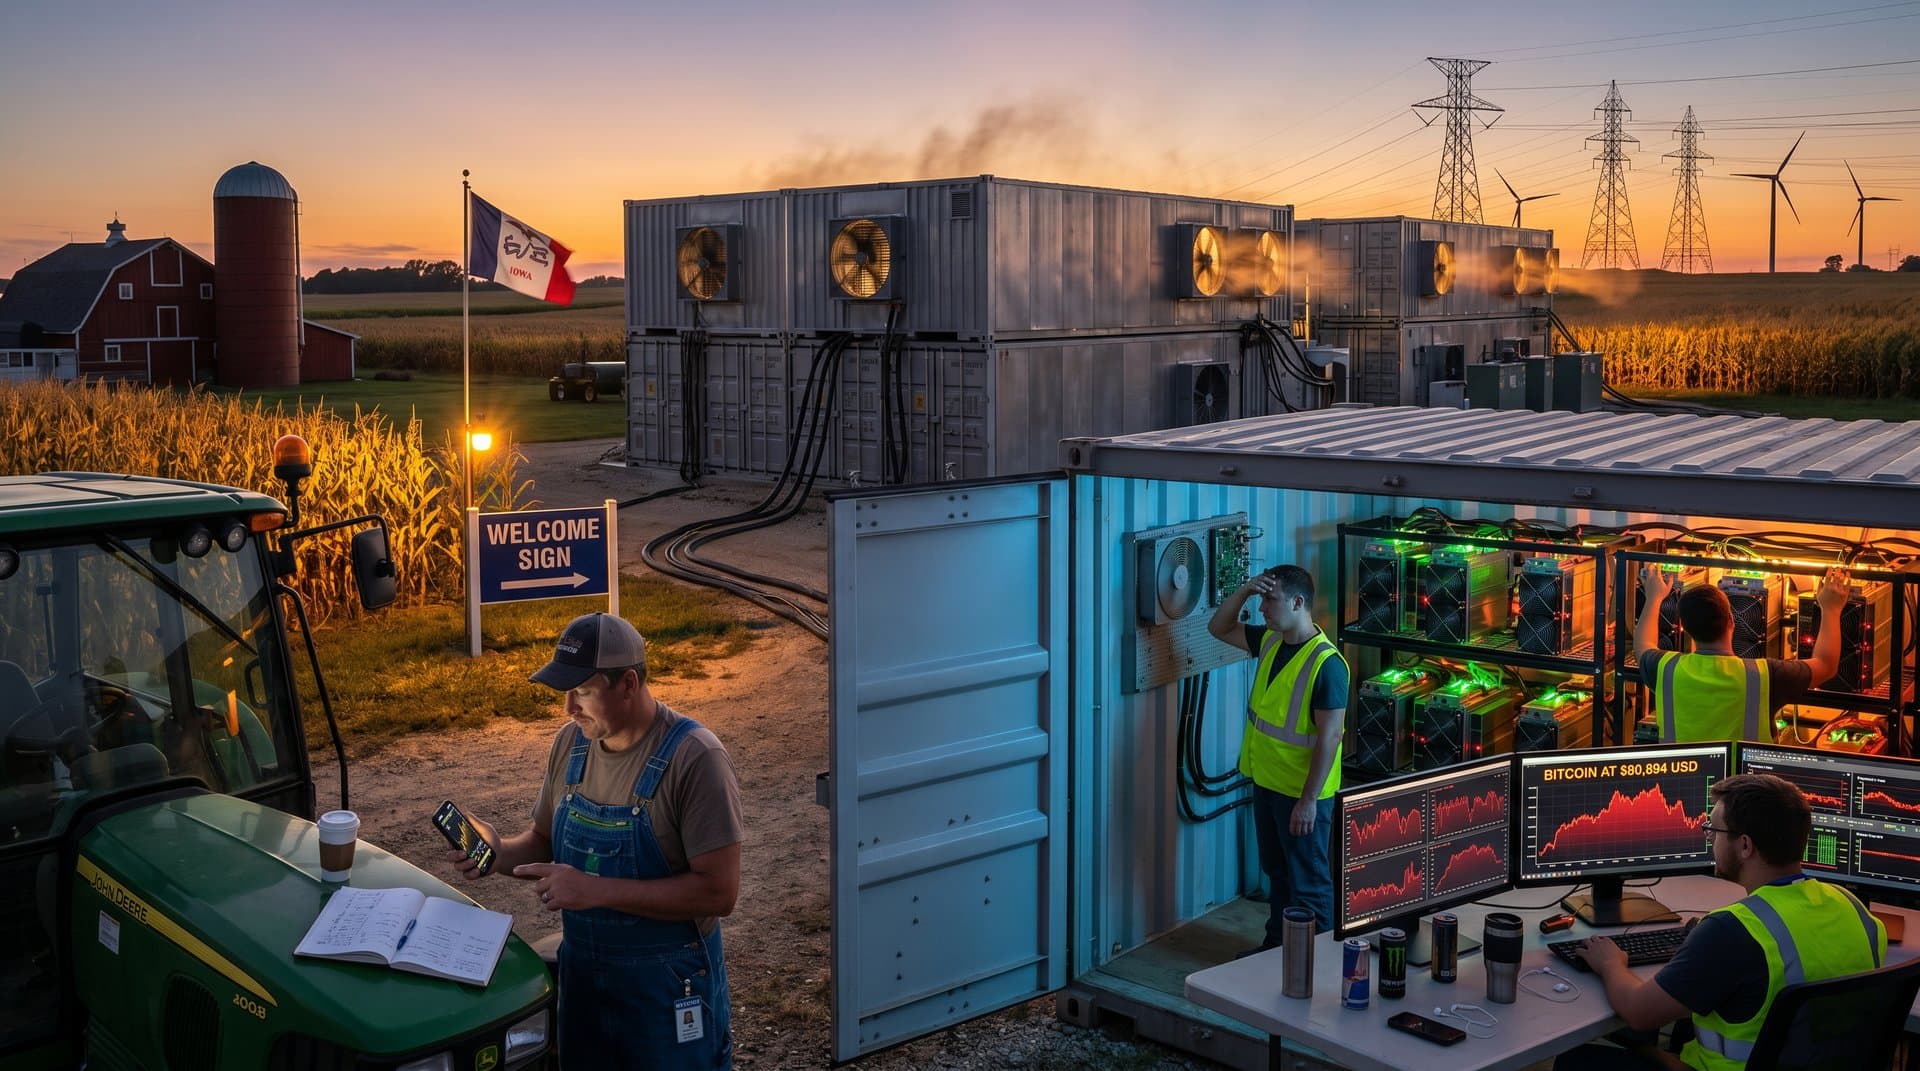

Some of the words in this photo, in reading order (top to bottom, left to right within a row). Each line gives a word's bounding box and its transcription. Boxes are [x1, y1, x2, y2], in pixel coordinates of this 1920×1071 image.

[510, 266, 532, 280] IOWA
[487, 518, 600, 545] WELCOME
[518, 546, 571, 570] SIGN
[1544, 767, 1598, 781] BITCOIN
[1600, 765, 1617, 777] AT
[1620, 762, 1667, 777] $80,894
[1671, 760, 1698, 773] USD
[90, 872, 115, 900] JOHN
[115, 887, 148, 922] DEERE
